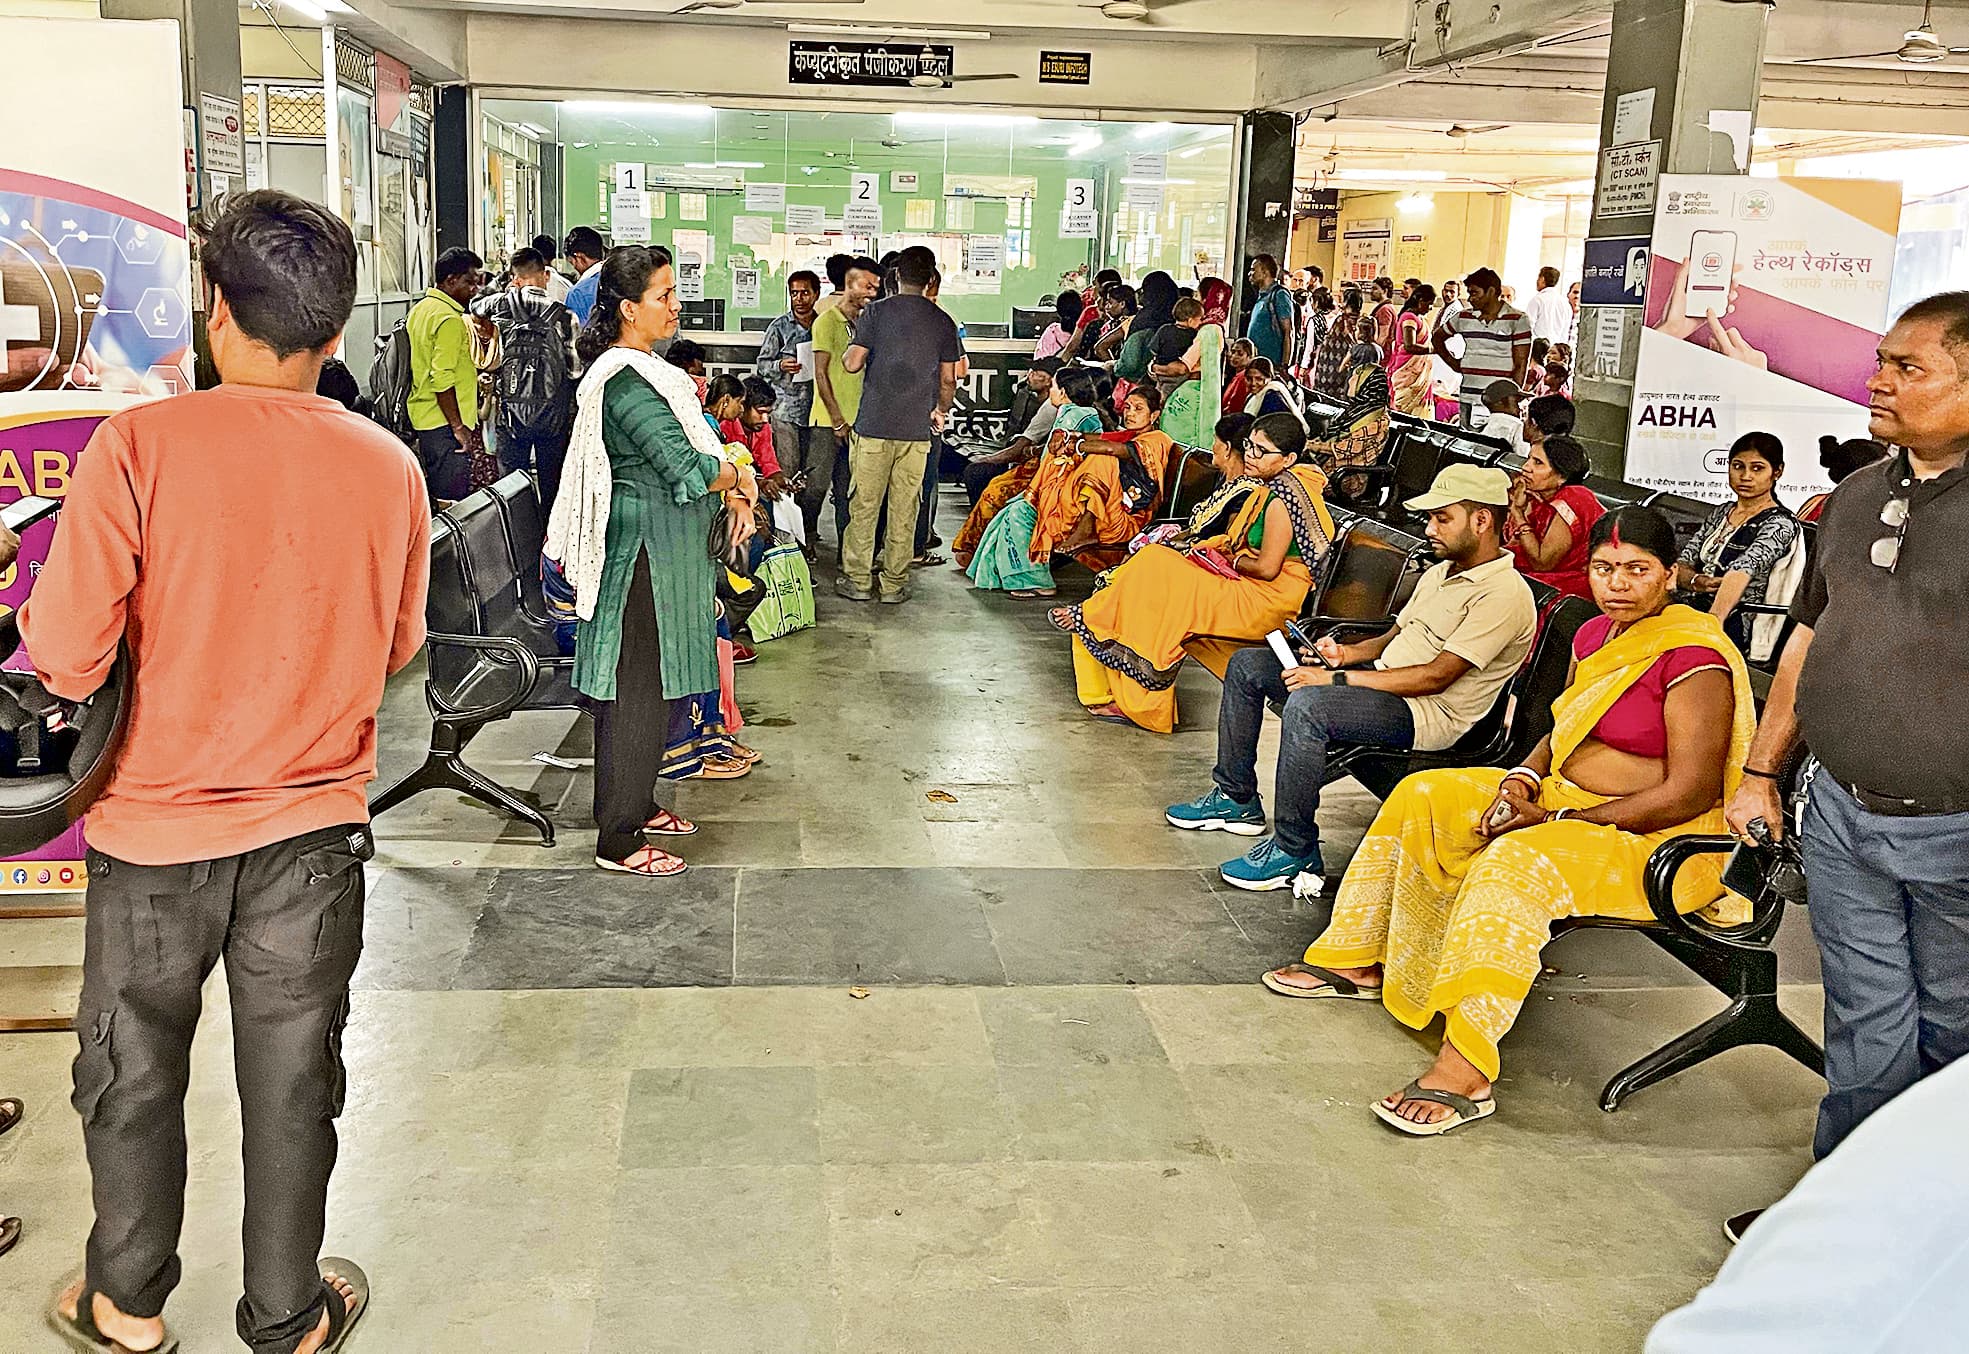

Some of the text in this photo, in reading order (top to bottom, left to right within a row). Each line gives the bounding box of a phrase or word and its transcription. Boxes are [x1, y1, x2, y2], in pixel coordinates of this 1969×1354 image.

[863, 48, 918, 76] पंजीकरण
[624, 169, 637, 190] 1
[1610, 166, 1648, 181] (CT SCAN)
[858, 180, 870, 200] 2
[1073, 186, 1085, 206] 3
[1753, 249, 1797, 271] हेल्थ
[1637, 404, 1717, 429] ABHA
